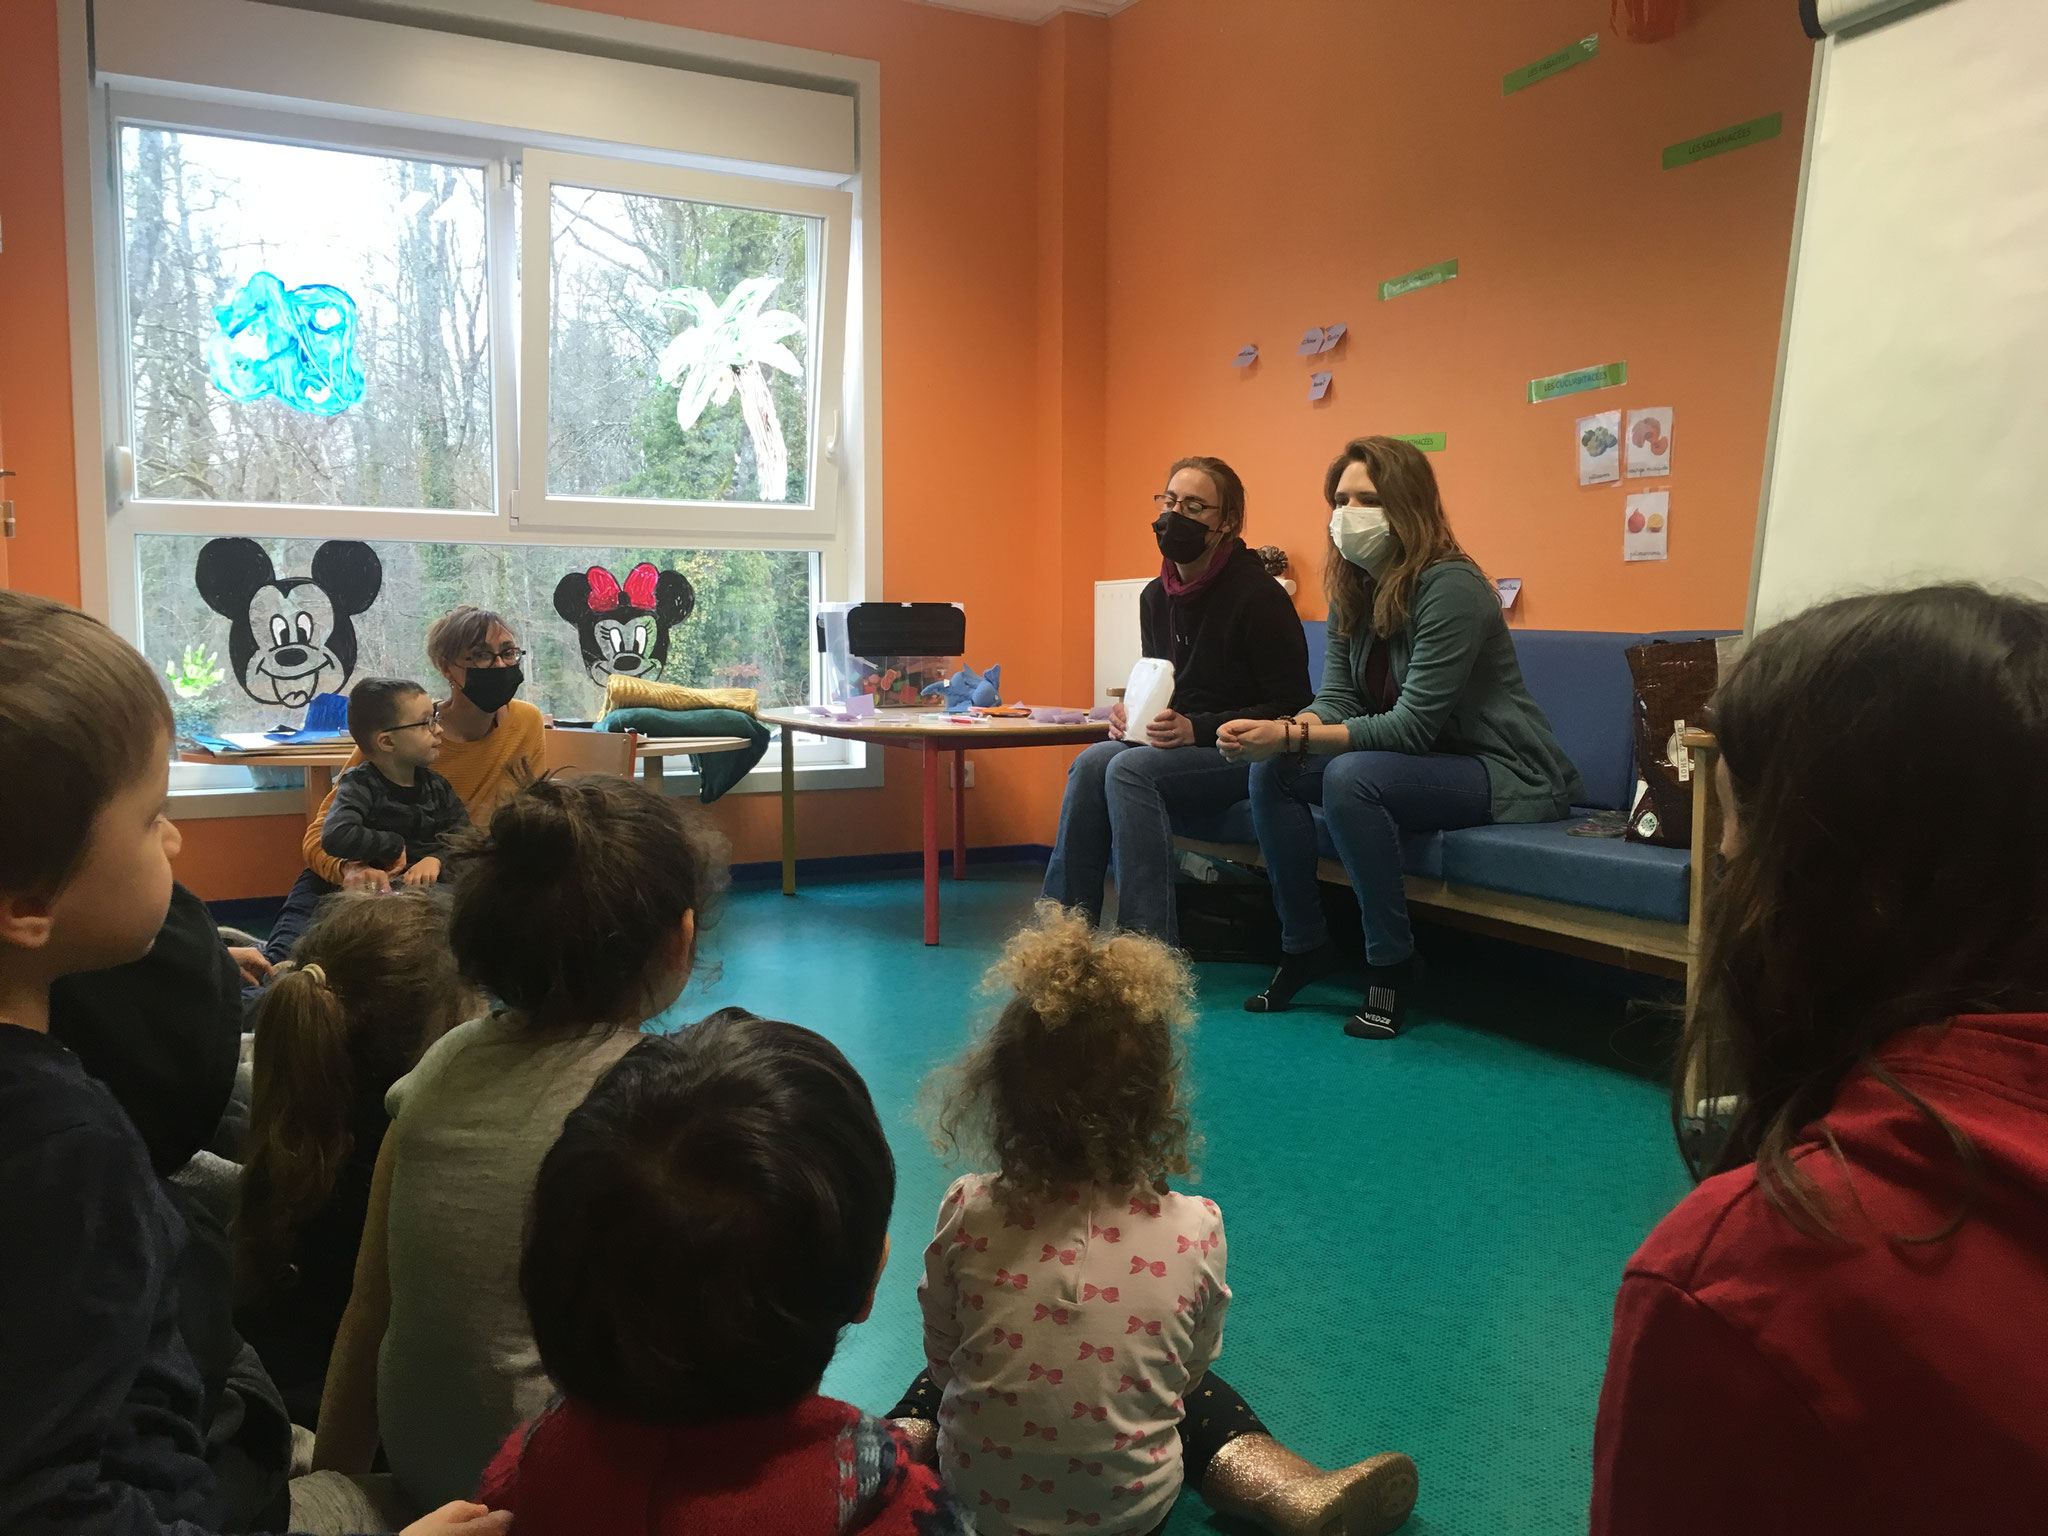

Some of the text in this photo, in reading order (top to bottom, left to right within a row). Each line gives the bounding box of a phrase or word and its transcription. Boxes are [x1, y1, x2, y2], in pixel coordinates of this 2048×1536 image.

[1688, 143, 1700, 155] LES
[1544, 382, 1556, 393] LES
[1680, 757, 1688, 779] SHOP
[1364, 1011, 1392, 1025] WEDZE
